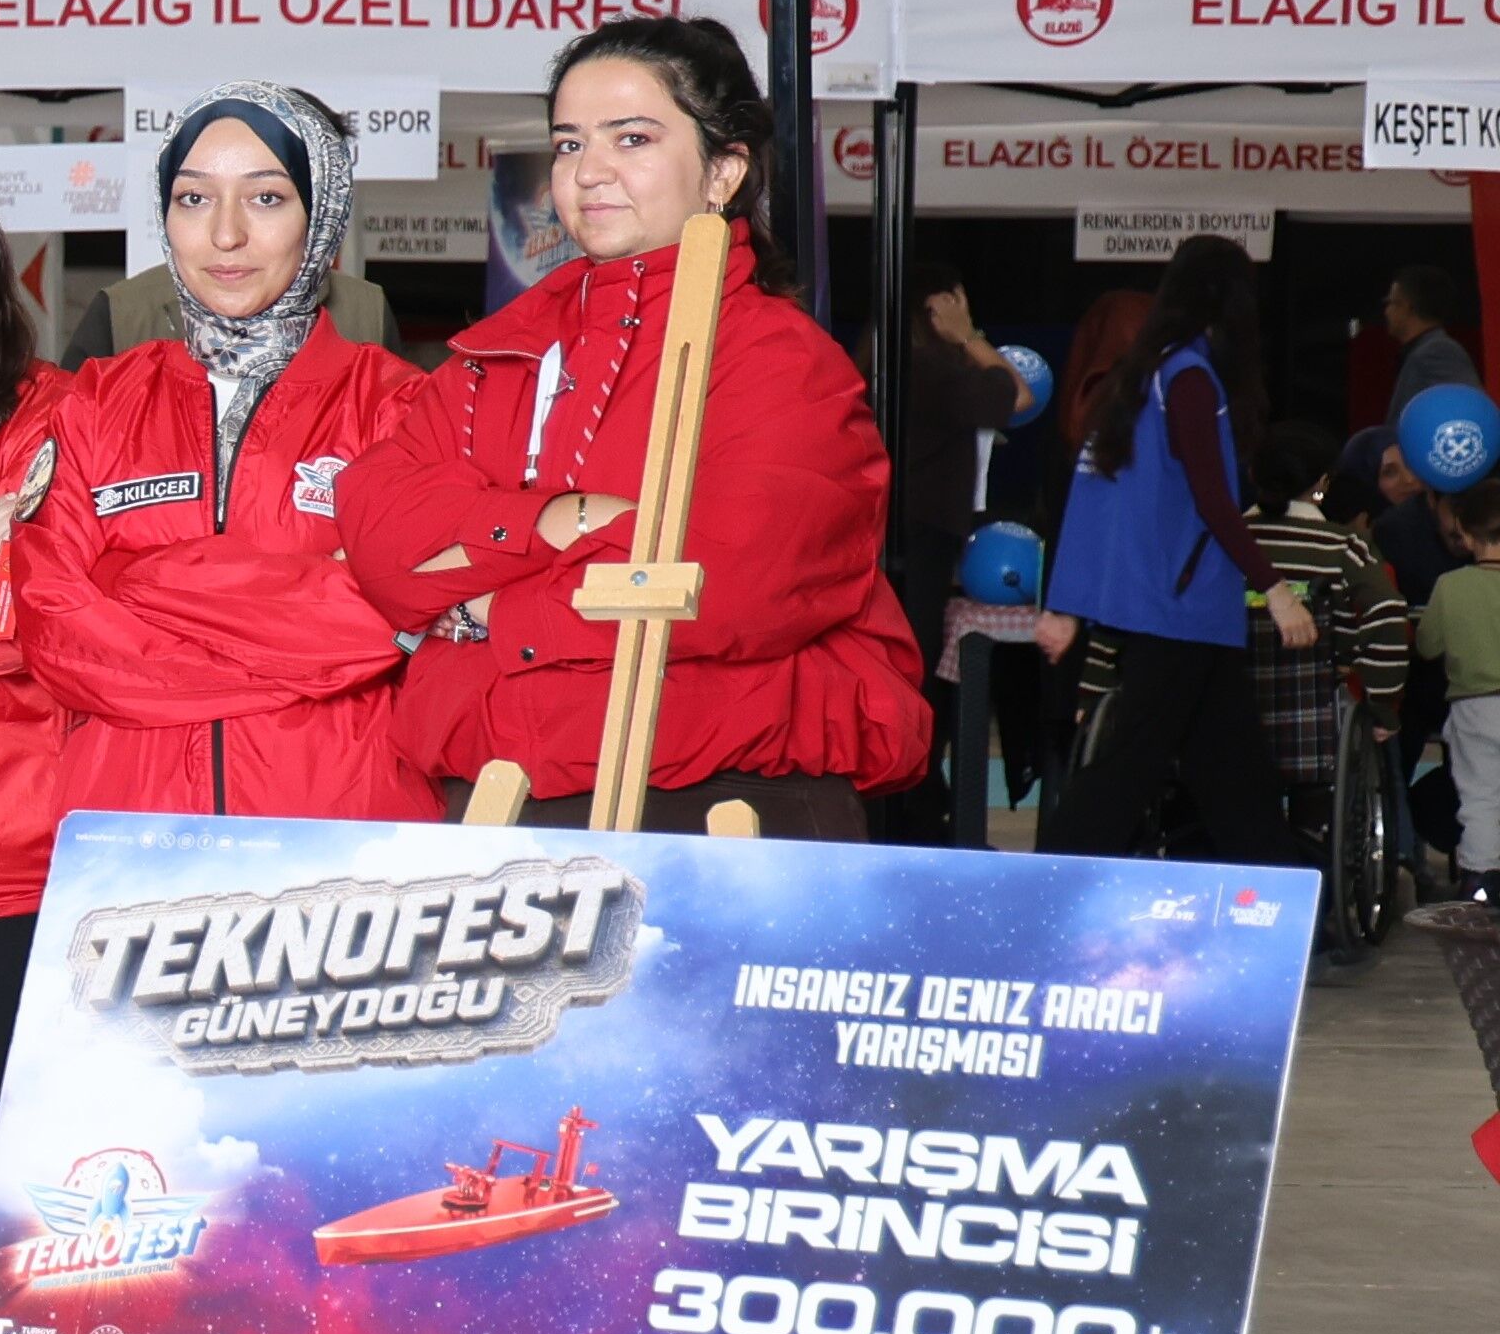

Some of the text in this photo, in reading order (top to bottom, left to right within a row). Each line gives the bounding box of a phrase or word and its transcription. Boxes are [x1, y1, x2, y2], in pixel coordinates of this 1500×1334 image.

[368, 109, 431, 134] SPOR
[1374, 102, 1470, 156] KEŞFET
[943, 135, 1364, 172] ELAZIĞ İL ÖZEL İDARES
[1083, 213, 1183, 231] RENKLERDEN
[1200, 213, 1271, 231] BOYUTLU
[1105, 234, 1173, 254] DÜNYAYA
[124, 478, 190, 502] KILIÇER
[88, 870, 625, 1009] TEKNOFEST
[172, 972, 505, 1047] GÜNEYDOĞU
[1043, 985, 1164, 1035] ARACI
[835, 1021, 1044, 1079] YARIŞMASI
[694, 1113, 1149, 1206] YARIŞMA
[13, 1216, 208, 1280] TEKNOFEST
